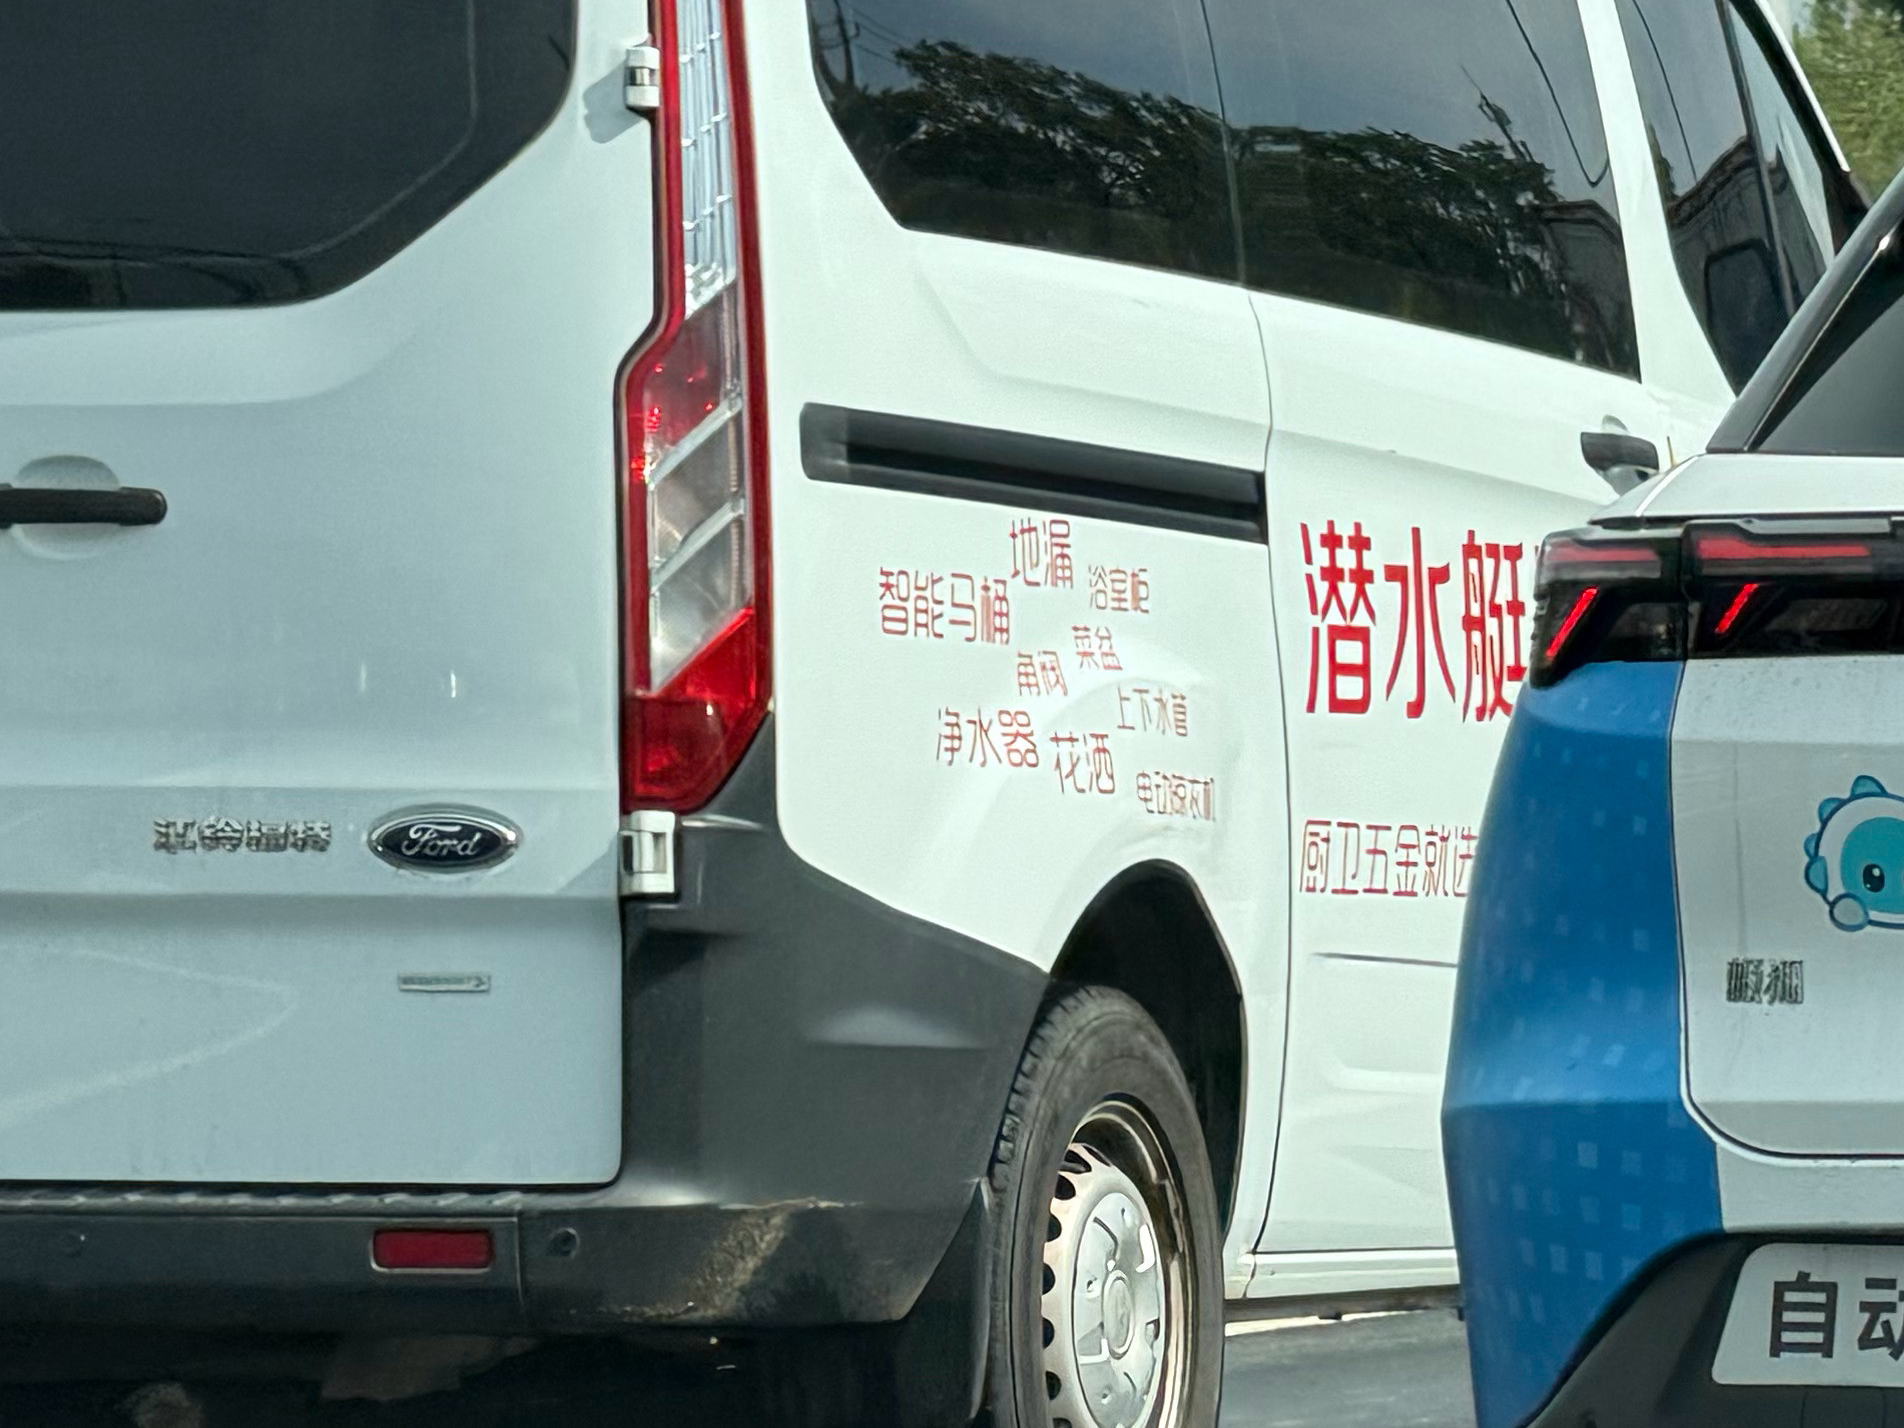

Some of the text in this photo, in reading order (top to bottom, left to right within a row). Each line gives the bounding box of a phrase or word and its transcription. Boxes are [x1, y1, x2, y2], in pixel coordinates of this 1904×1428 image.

[1008, 517, 1074, 589] 地漏
[879, 567, 1010, 645] 智能马桶
[1087, 564, 1150, 614] 浴室柜
[1071, 624, 1123, 672] 菜盆
[1300, 519, 1527, 723] 潜水艇
[1016, 648, 1068, 698] 角阀
[936, 707, 1040, 769] 净水器
[1117, 685, 1188, 738] 上下水管
[1050, 731, 1116, 795] 花洒
[401, 823, 483, 857] Ford
[1300, 820, 1478, 898] 厨卫五金就选
